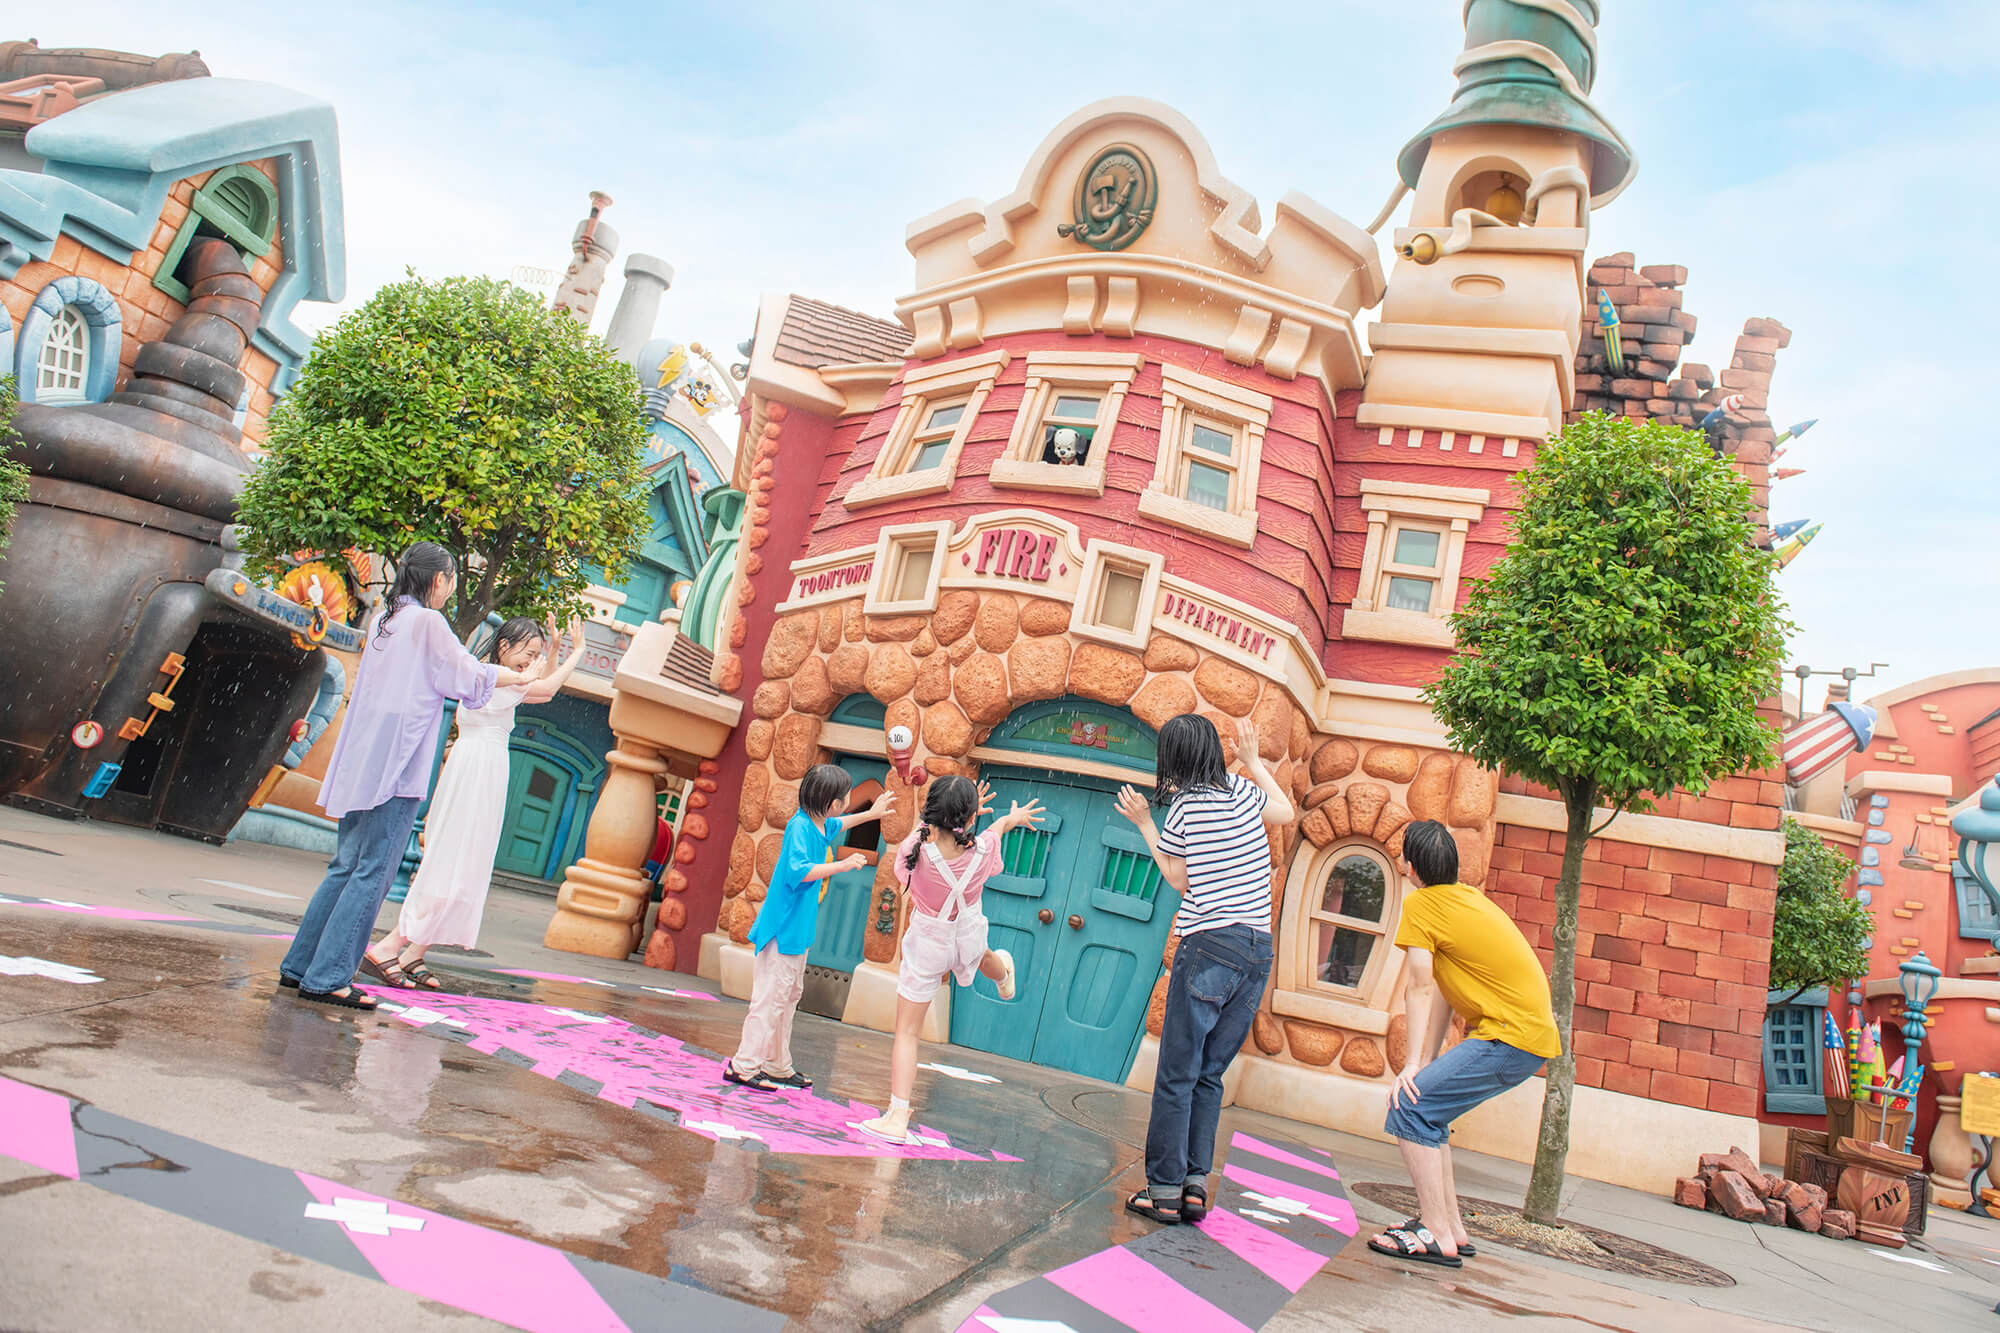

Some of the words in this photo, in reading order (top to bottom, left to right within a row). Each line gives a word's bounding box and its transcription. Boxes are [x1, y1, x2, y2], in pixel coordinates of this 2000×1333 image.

[799, 562, 873, 598] TOONTOWN
[974, 528, 1058, 582] FIRE
[1162, 593, 1276, 660] DEPARTMENT
[1872, 1186, 1902, 1211] TNT
